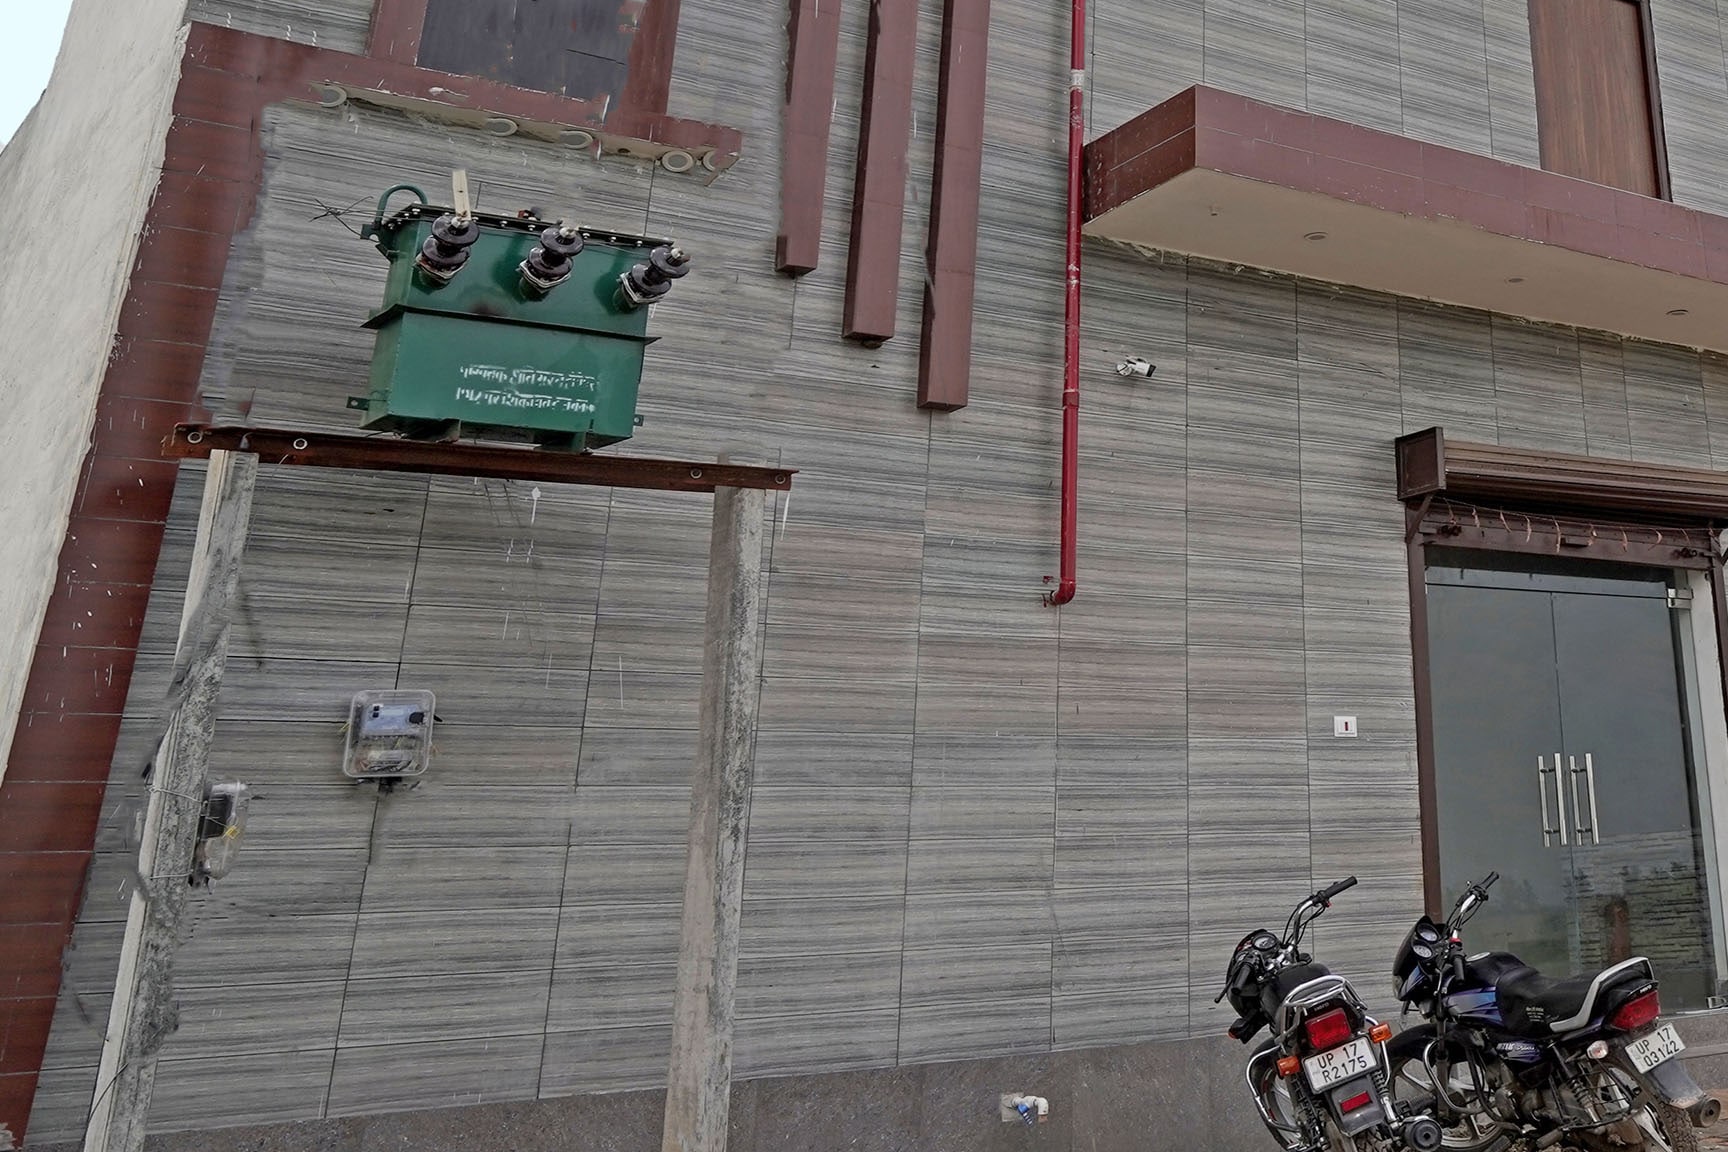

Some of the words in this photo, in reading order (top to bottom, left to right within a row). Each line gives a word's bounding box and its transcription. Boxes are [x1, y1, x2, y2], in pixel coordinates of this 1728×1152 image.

[1635, 1039, 1650, 1054] UP
[1657, 1027, 1670, 1042] 17
[1317, 1052, 1334, 1069] UP
[1342, 1043, 1358, 1058] 17
[1322, 1055, 1367, 1083] R2175
